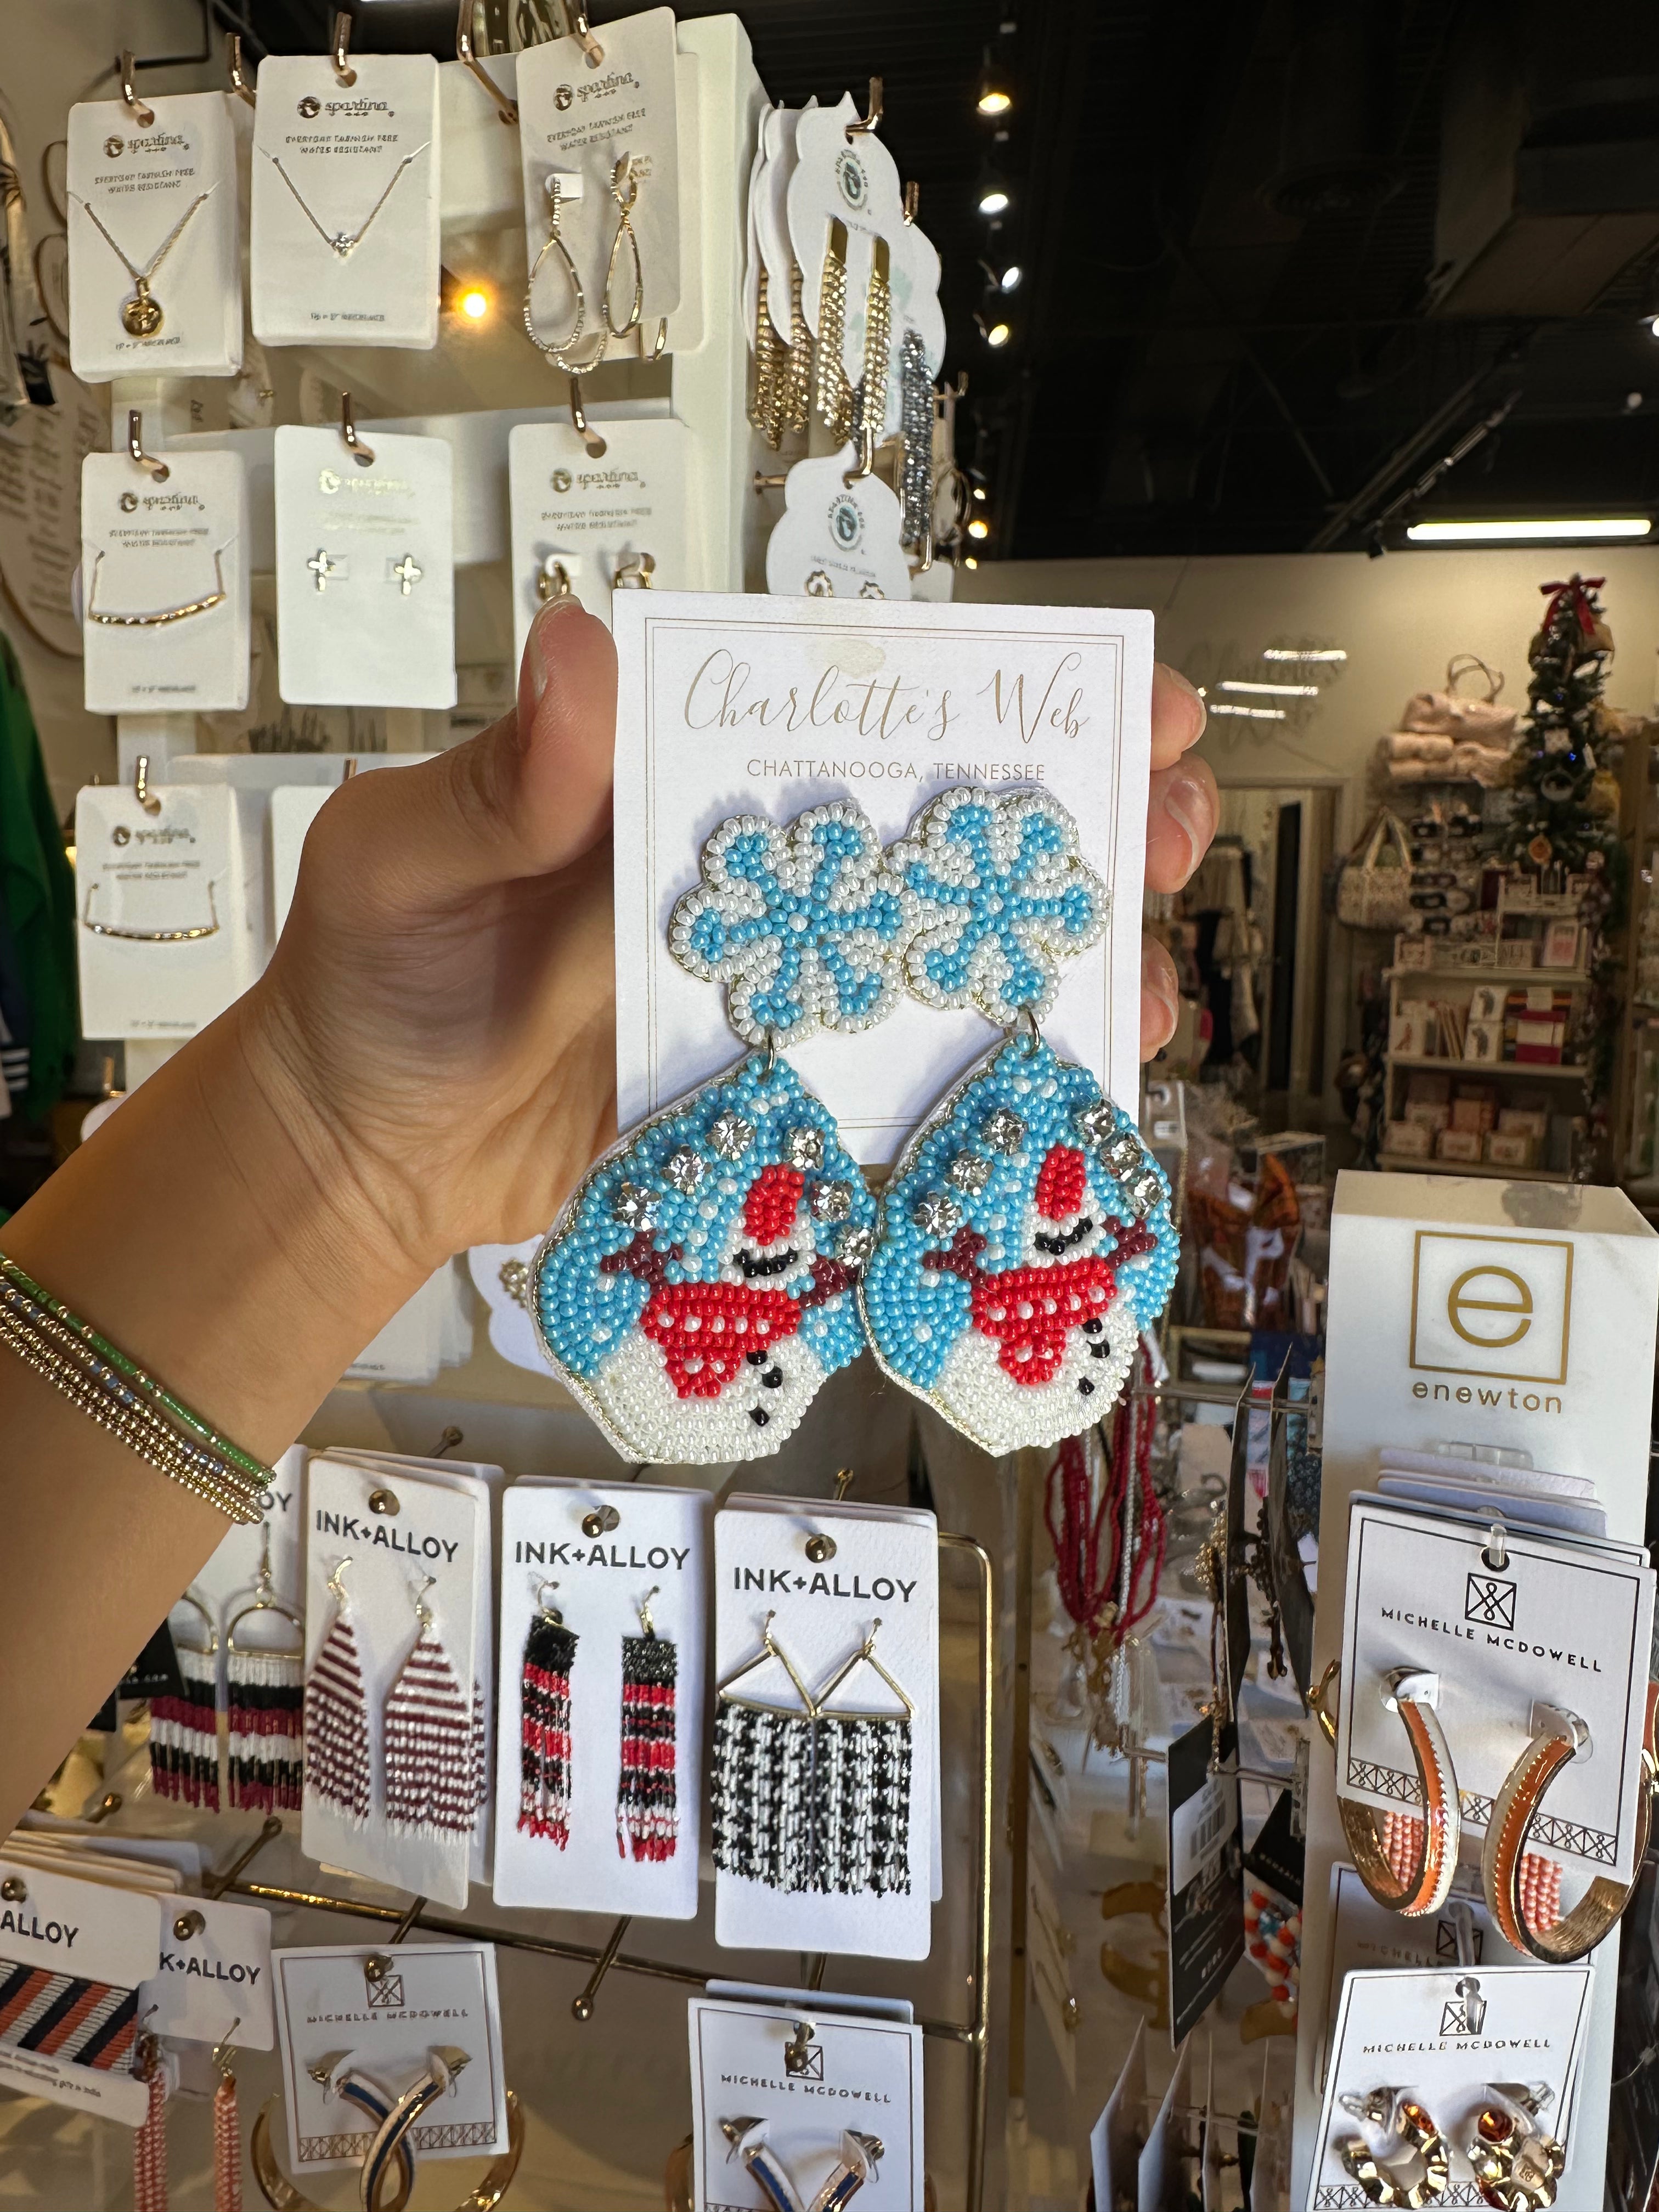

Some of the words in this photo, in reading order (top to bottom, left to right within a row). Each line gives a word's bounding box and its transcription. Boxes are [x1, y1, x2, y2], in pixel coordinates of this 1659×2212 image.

[577, 72, 634, 102] spartina
[324, 98, 389, 117] spartina
[685, 649, 960, 741] Charlotte's
[977, 652, 1091, 743] Web
[747, 759, 923, 782] CHATTANOOGA,
[932, 763, 1045, 780] TENNESSEE
[1448, 1265, 1533, 1347] e
[1412, 1381, 1562, 1413] enewton
[317, 1510, 459, 1563] INK+ALLOY
[515, 1541, 691, 1570] INK+ALLOY
[734, 1567, 917, 1602] INK+ALLOY
[1382, 1607, 1475, 1640] MICHELLE
[1487, 1633, 1602, 1673] MCDOWELL
[0, 1910, 79, 1948] ALLOY
[159, 1952, 261, 1985] K+ALLOY
[1364, 2041, 1447, 2053] MICHELLE
[1457, 2039, 1550, 2051] MCDOWELL
[721, 2074, 795, 2091] MICHELLE
[804, 2085, 891, 2103] MCDOWELL
